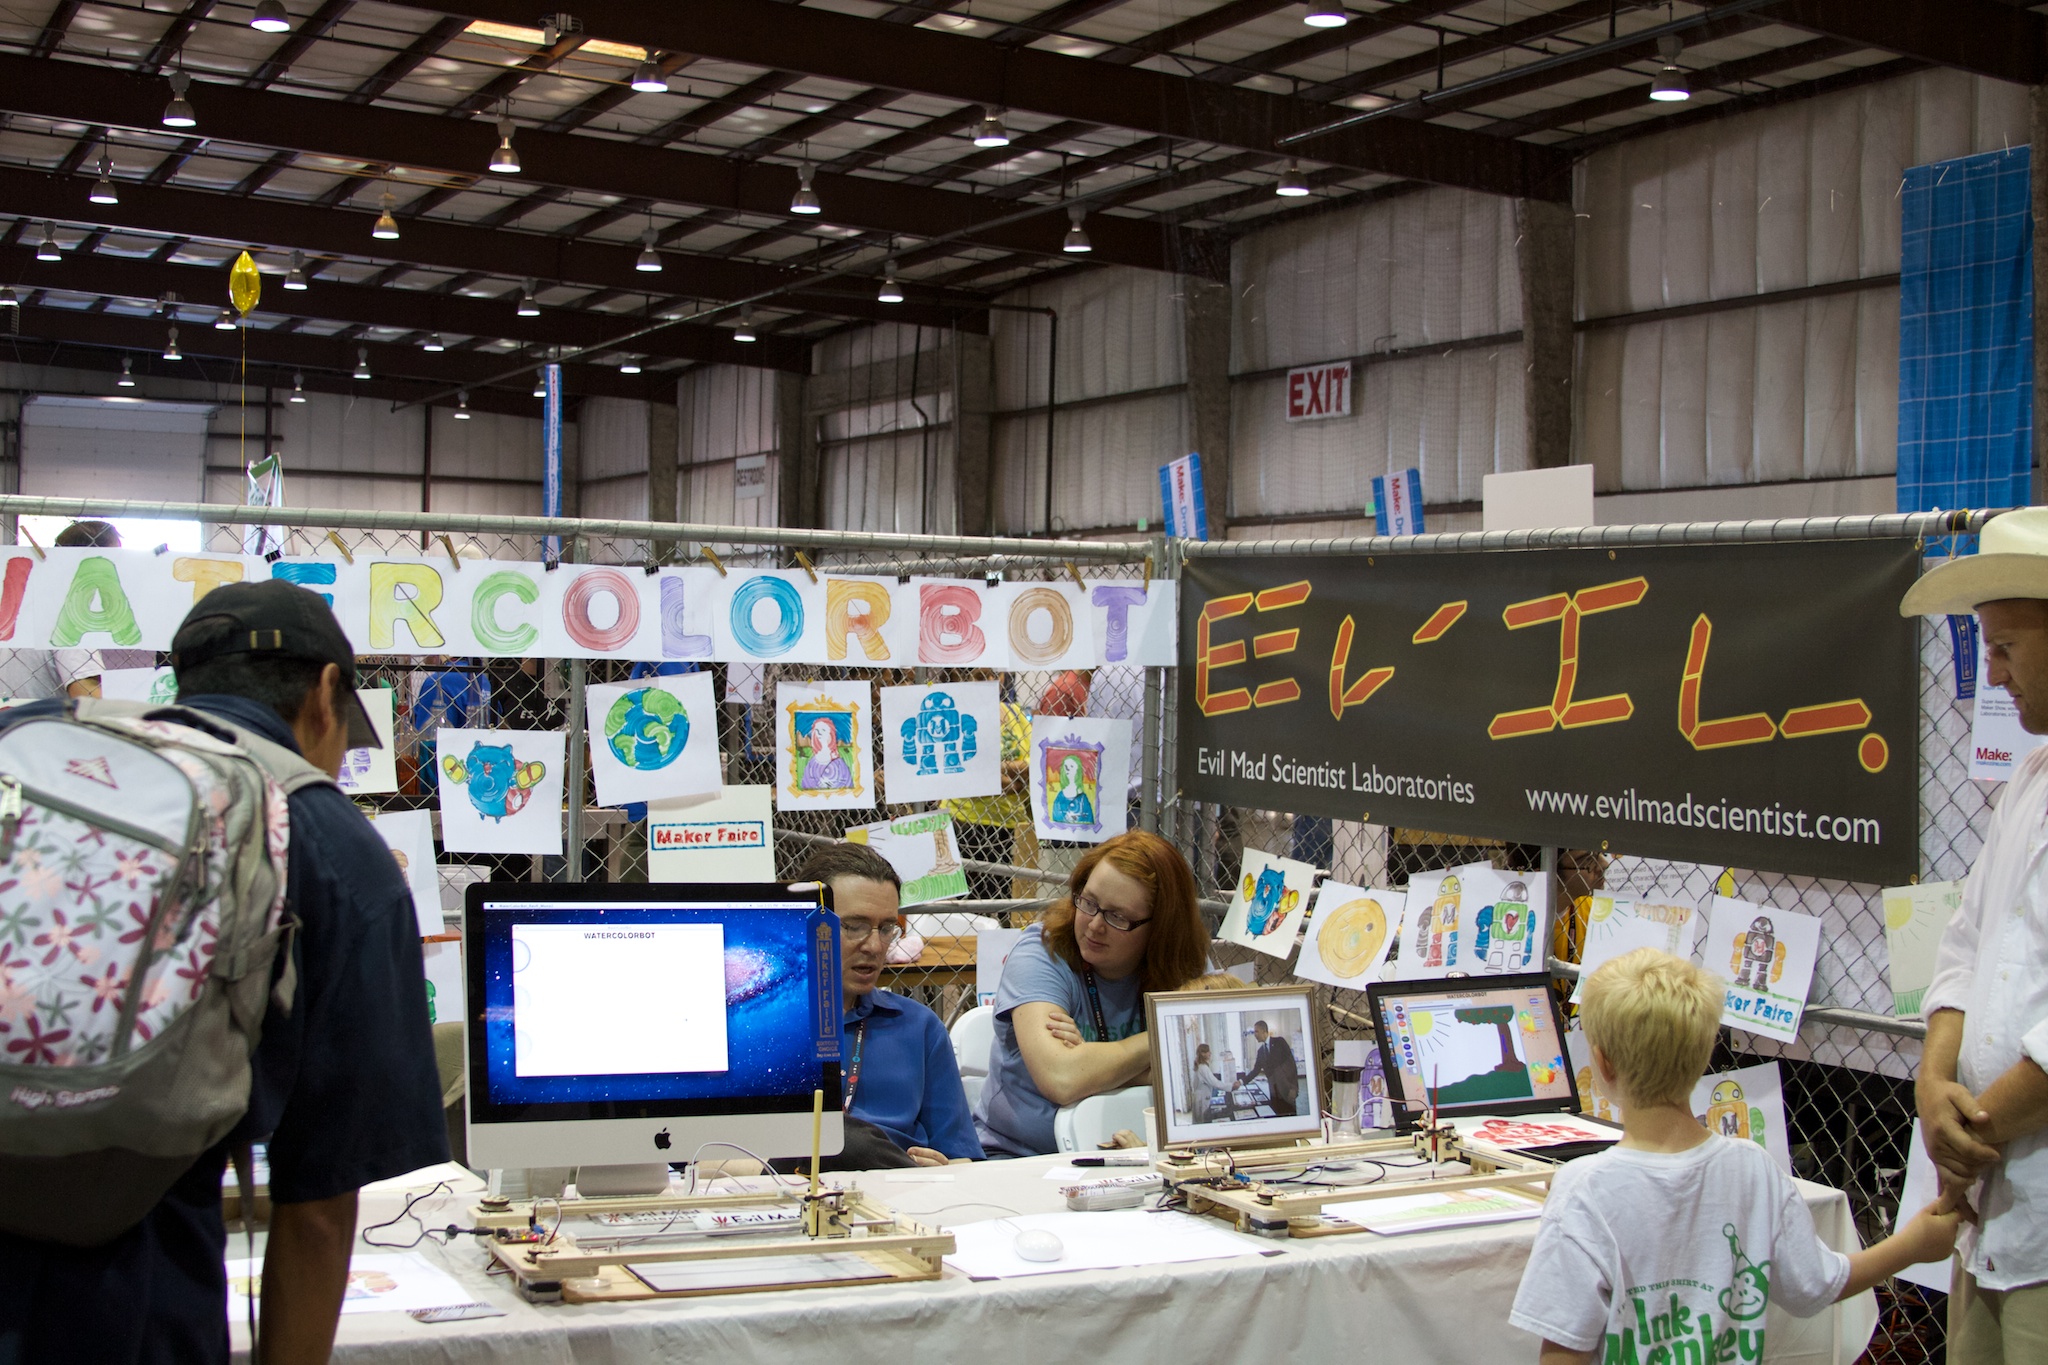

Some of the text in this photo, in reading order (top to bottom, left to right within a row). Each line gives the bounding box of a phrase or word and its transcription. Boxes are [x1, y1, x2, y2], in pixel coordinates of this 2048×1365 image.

[1289, 367, 1349, 417] EXIT
[1391, 477, 1402, 515] Make:
[1976, 747, 2012, 762] Make:
[1198, 747, 1475, 804] Evil Mad Scientist Laboratories
[1525, 788, 1880, 845] www.evilmadscientist.com
[584, 932, 655, 940] WATERCOLORBOT
[1724, 990, 1793, 1024] ker Faire
[1649, 1279, 1715, 1293] THIS SHIRT AT
[1632, 1292, 1694, 1345] Ink
